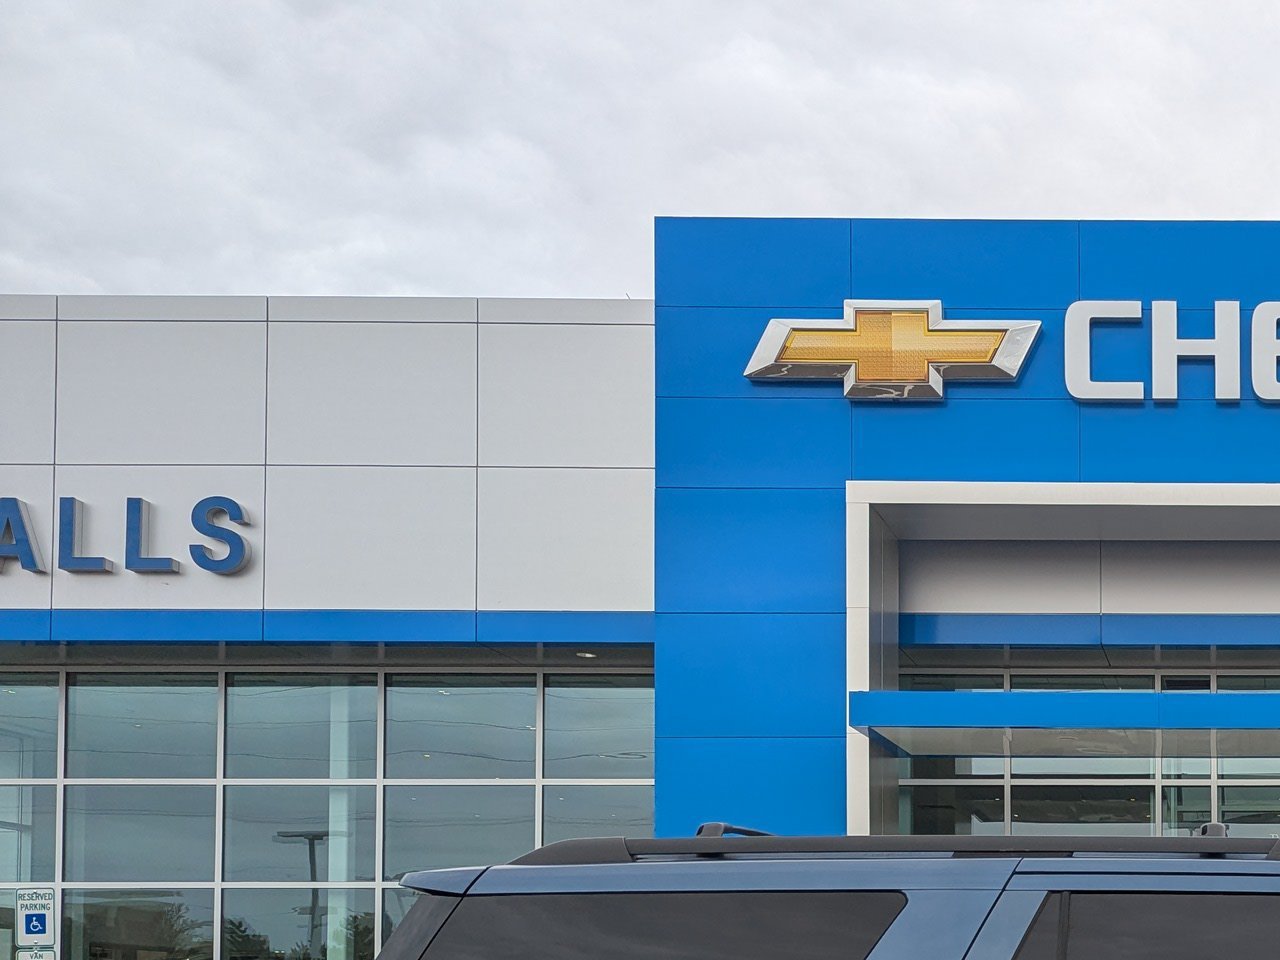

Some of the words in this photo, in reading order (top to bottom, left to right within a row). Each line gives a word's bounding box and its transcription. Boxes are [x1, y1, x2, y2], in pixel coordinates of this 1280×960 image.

[0, 495, 250, 575] ALLS
[18, 892, 53, 901] RESERVED
[20, 903, 51, 911] PARKING
